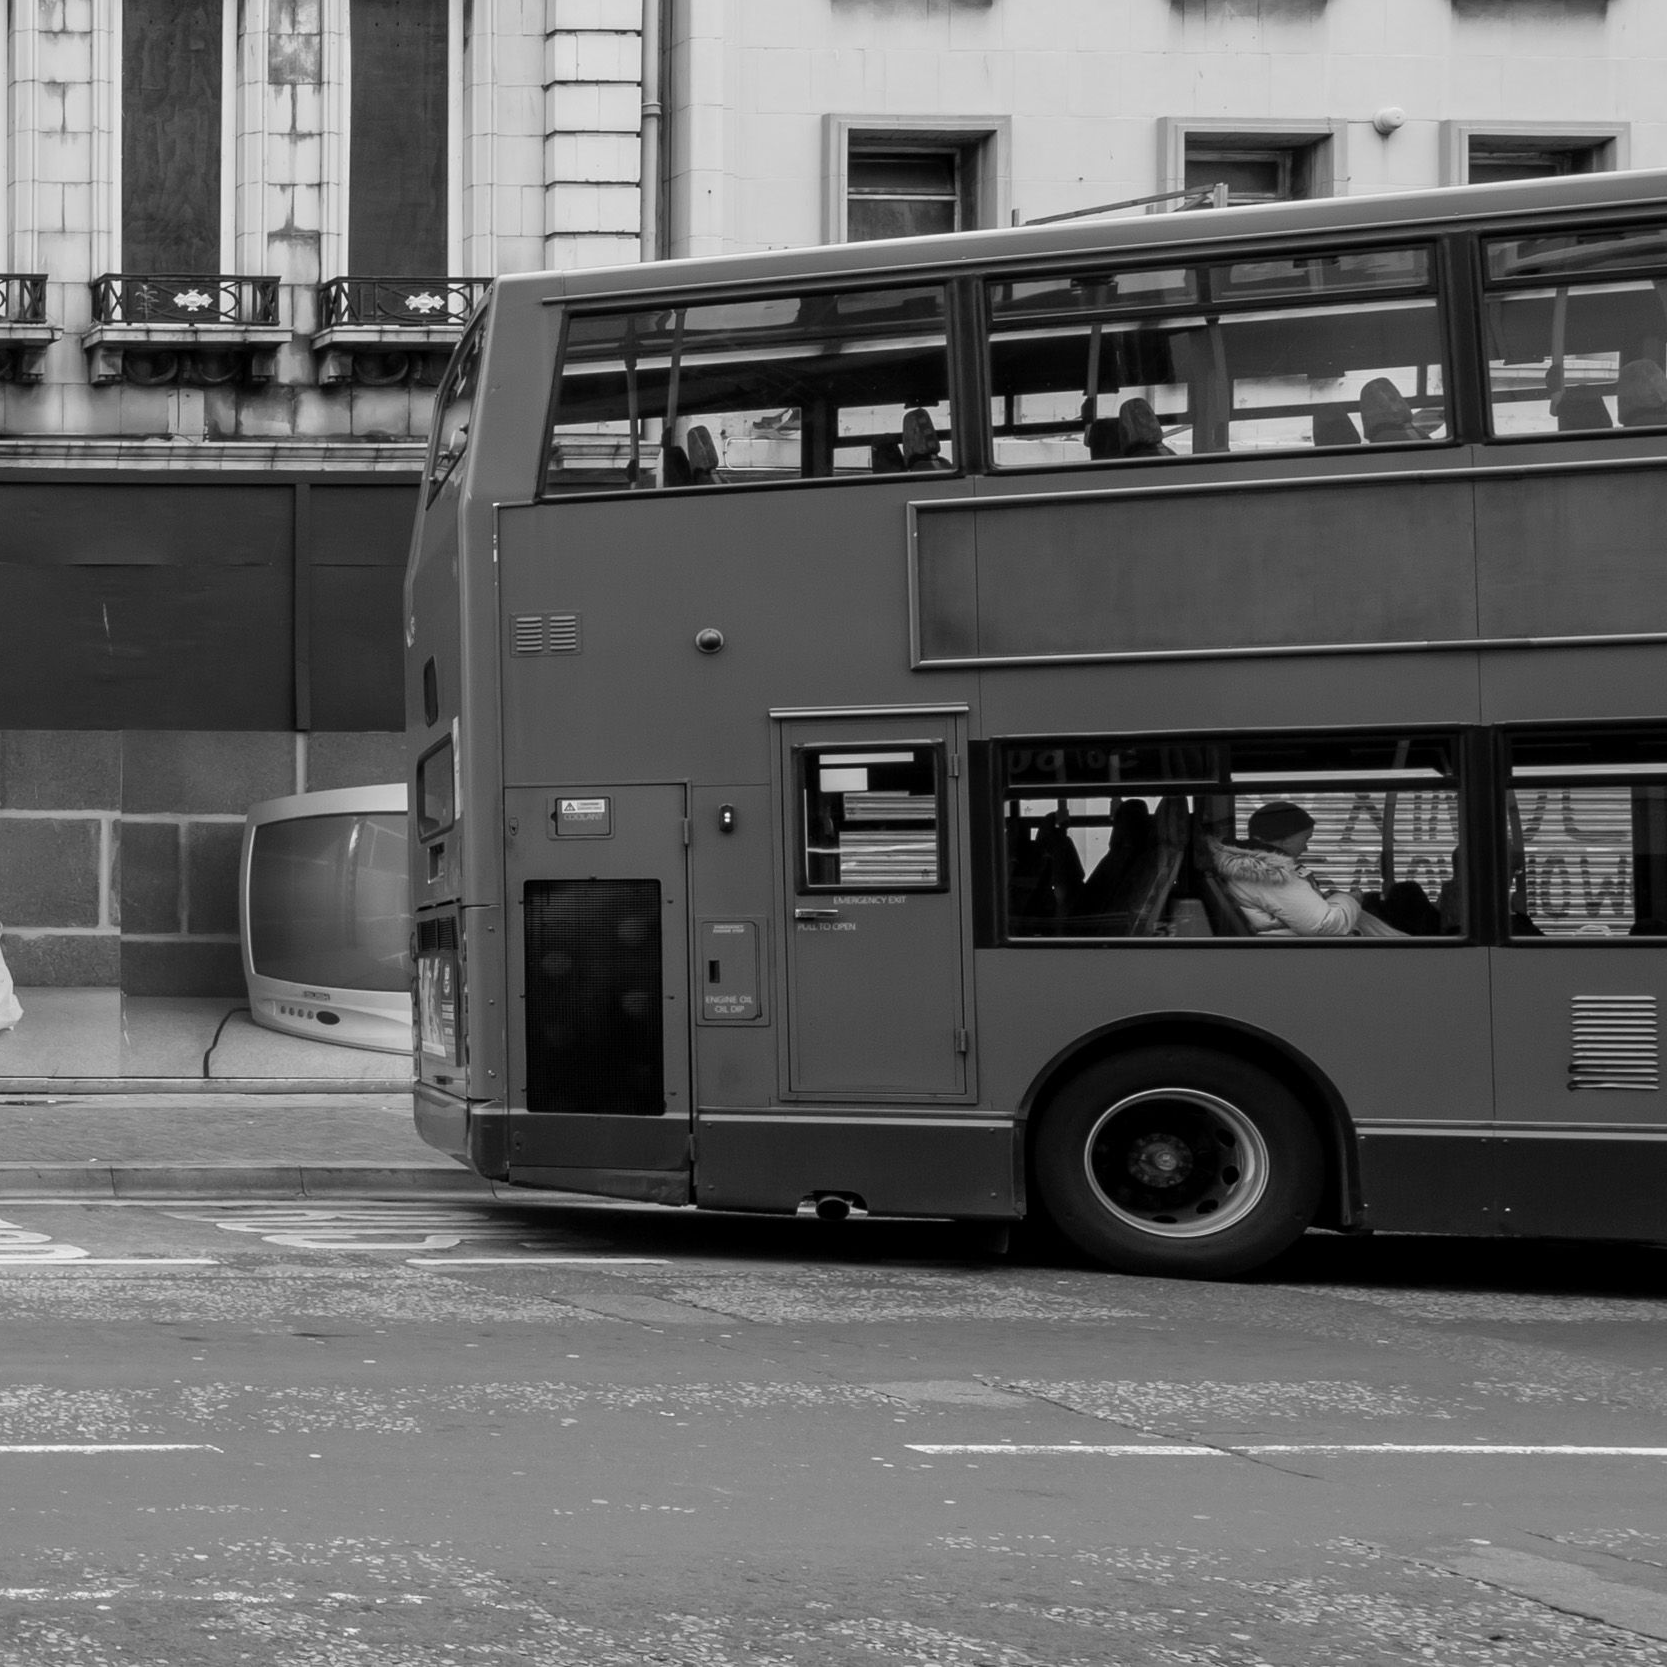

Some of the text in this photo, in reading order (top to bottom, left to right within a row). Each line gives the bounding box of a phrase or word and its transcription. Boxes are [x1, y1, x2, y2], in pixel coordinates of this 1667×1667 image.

[833, 895, 907, 904] EMERGENCY EXIT
[797, 923, 856, 931] PULL TO OPEN
[705, 995, 753, 1003] ENGINE OIL
[715, 1005, 745, 1013] OIL DIP
